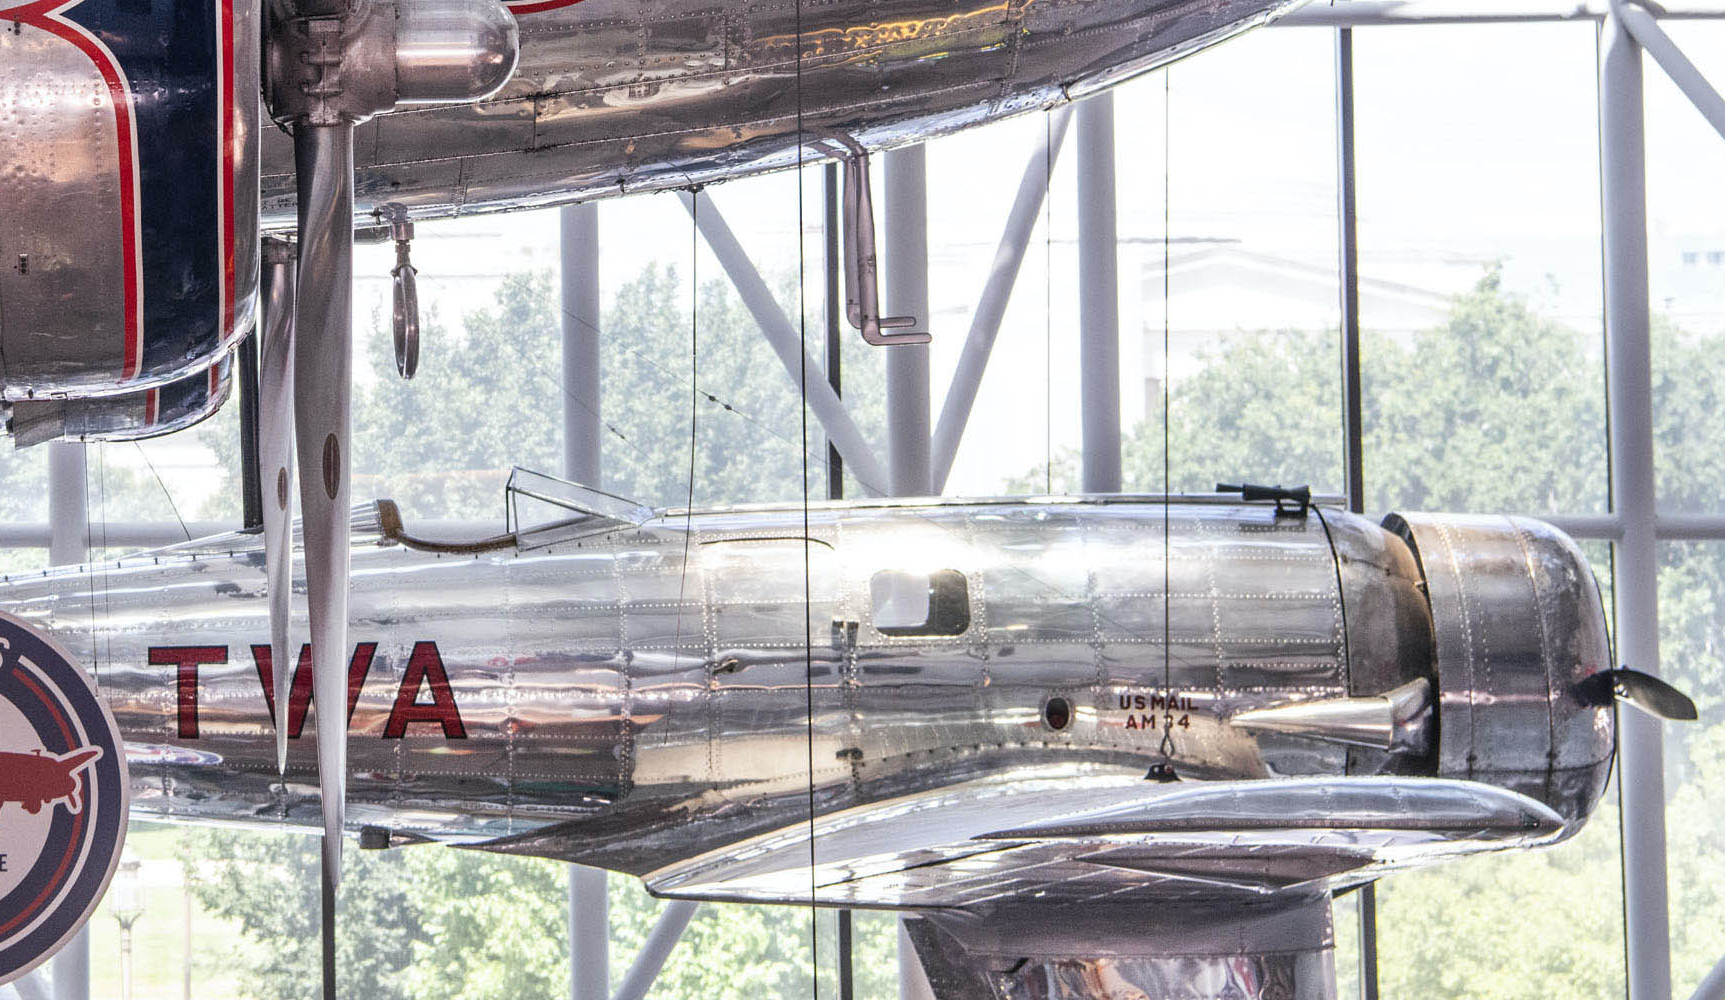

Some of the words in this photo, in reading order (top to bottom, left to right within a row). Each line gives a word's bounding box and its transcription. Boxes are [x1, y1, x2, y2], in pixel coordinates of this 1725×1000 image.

[148, 641, 467, 739] TWA
[1150, 695, 1199, 711] MAIL
[1125, 714, 1155, 729] AM
